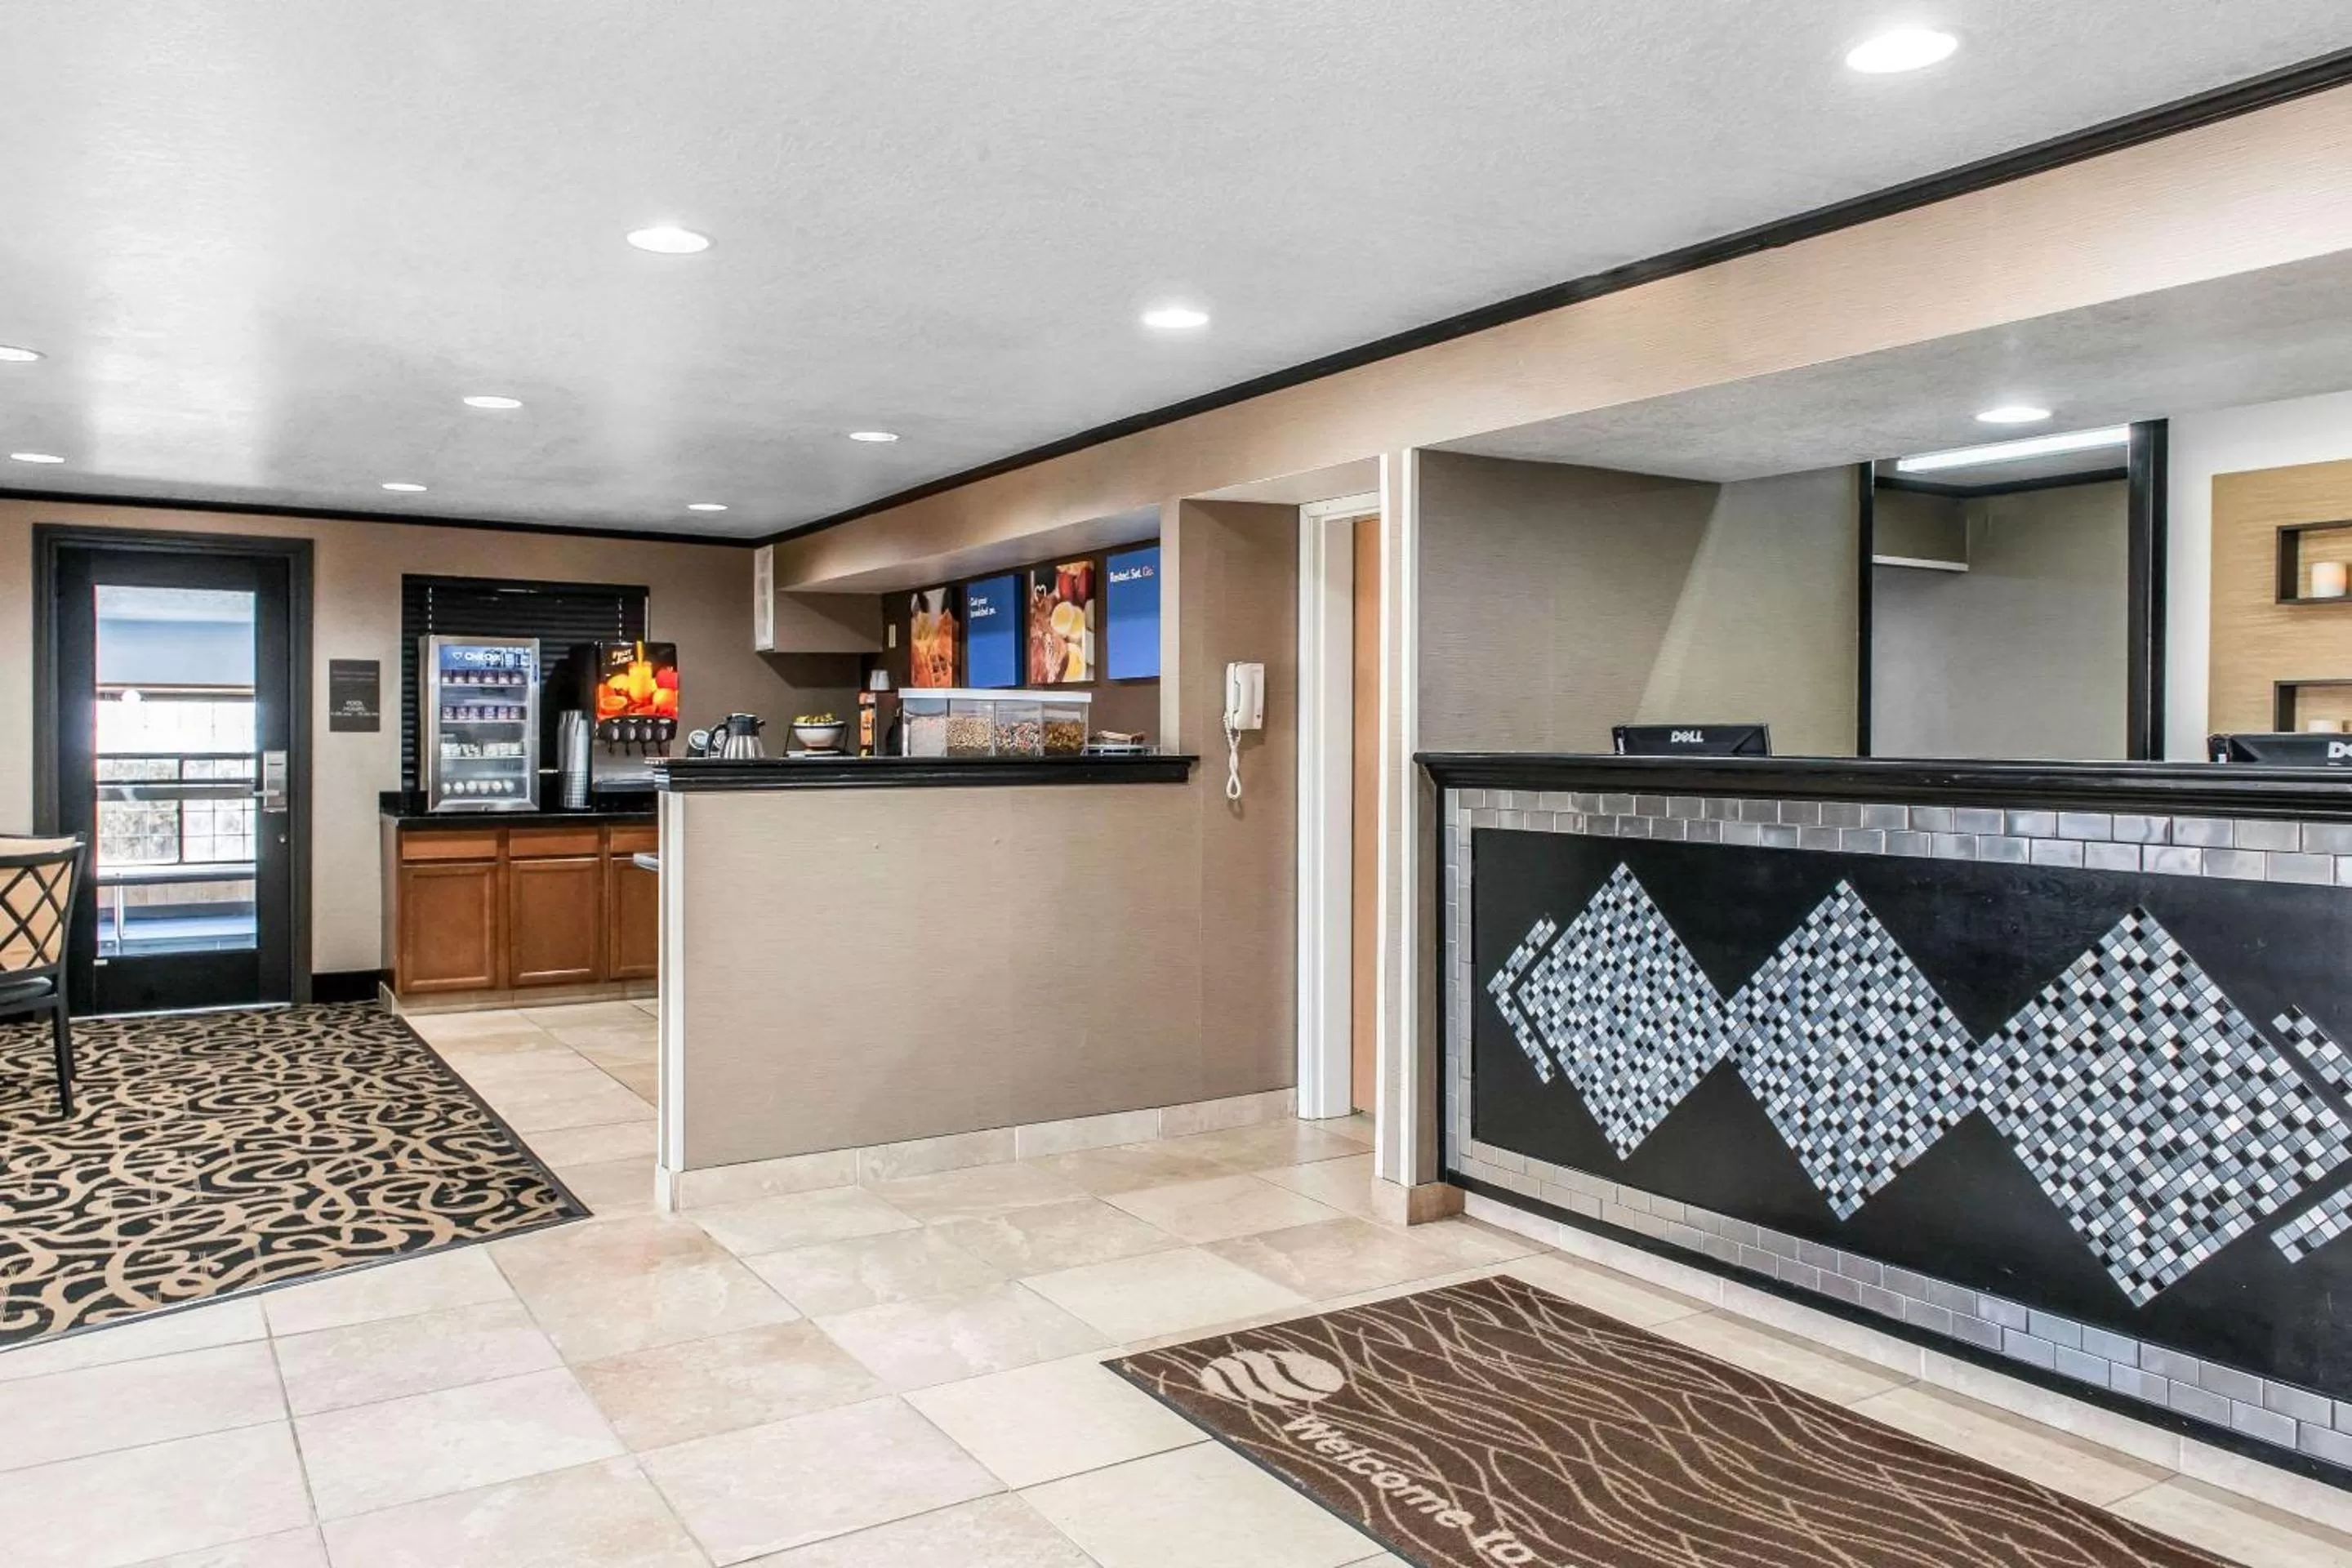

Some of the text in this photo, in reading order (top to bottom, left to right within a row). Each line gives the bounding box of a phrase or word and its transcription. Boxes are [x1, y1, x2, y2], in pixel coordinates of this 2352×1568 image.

[1670, 730, 1704, 742] DELL
[1282, 1413, 1534, 1565] Welcome to
